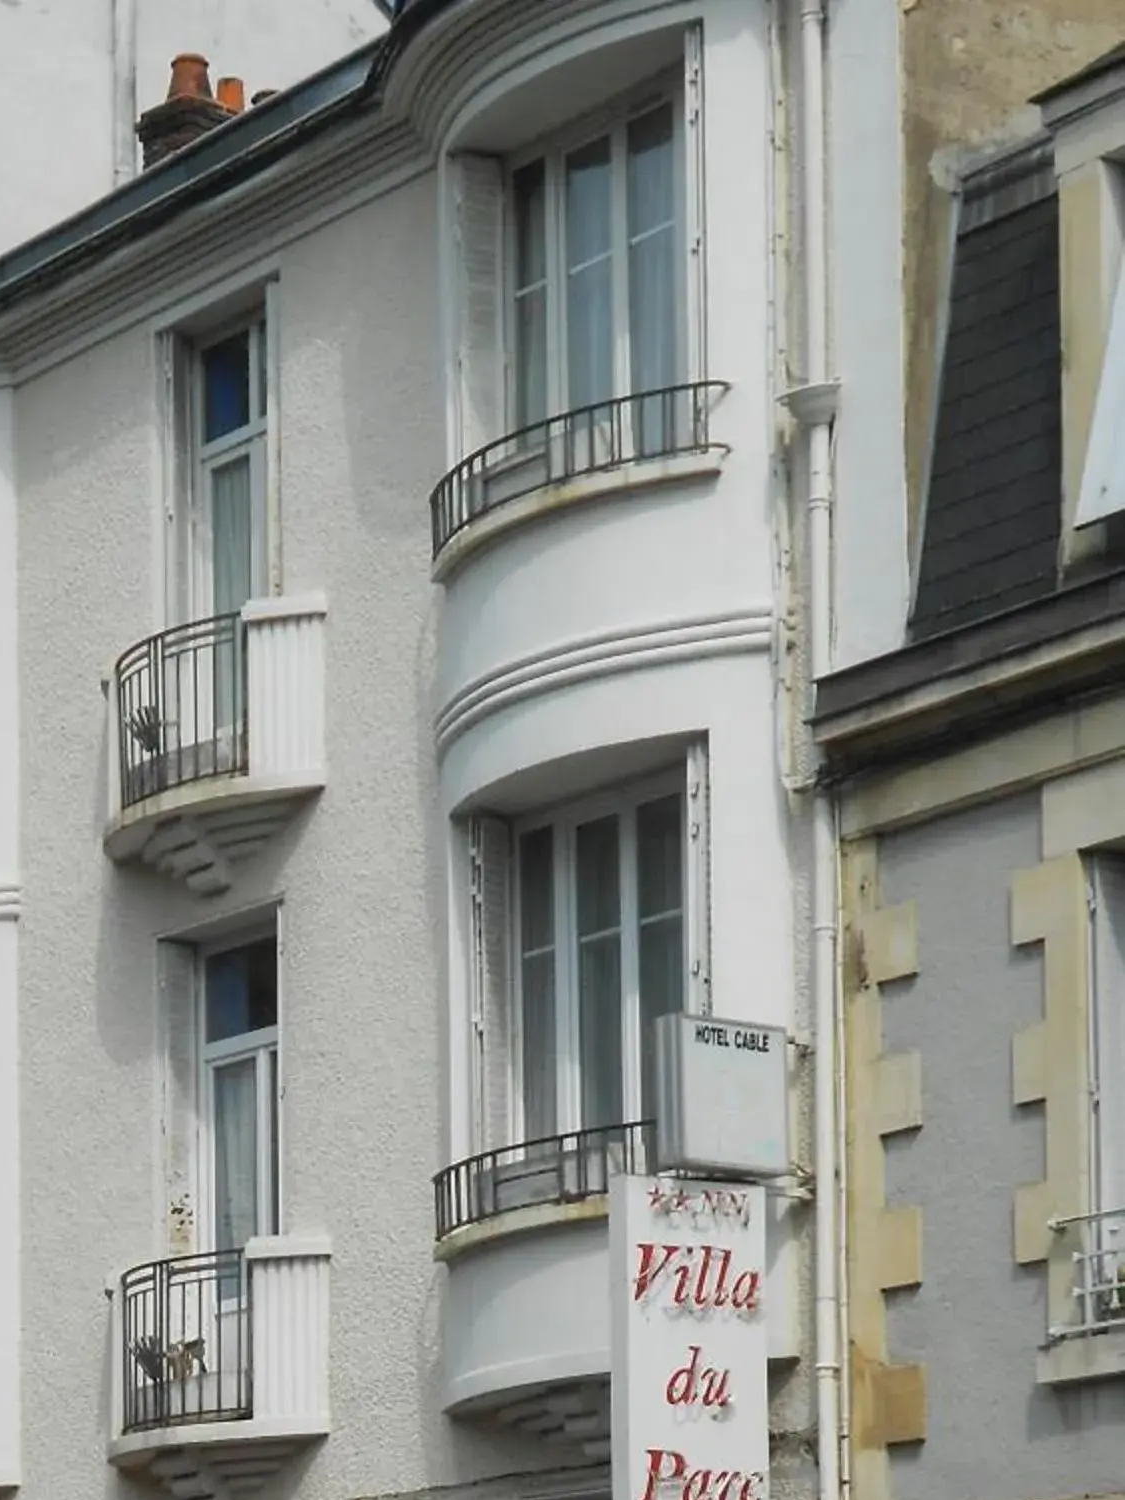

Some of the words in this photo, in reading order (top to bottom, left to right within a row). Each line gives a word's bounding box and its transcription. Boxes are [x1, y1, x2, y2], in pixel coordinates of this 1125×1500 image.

[694, 1024, 730, 1047] HOTEL
[733, 1030, 770, 1053] CABLE
[633, 1243, 761, 1310] Villa
[665, 1346, 731, 1408] du
